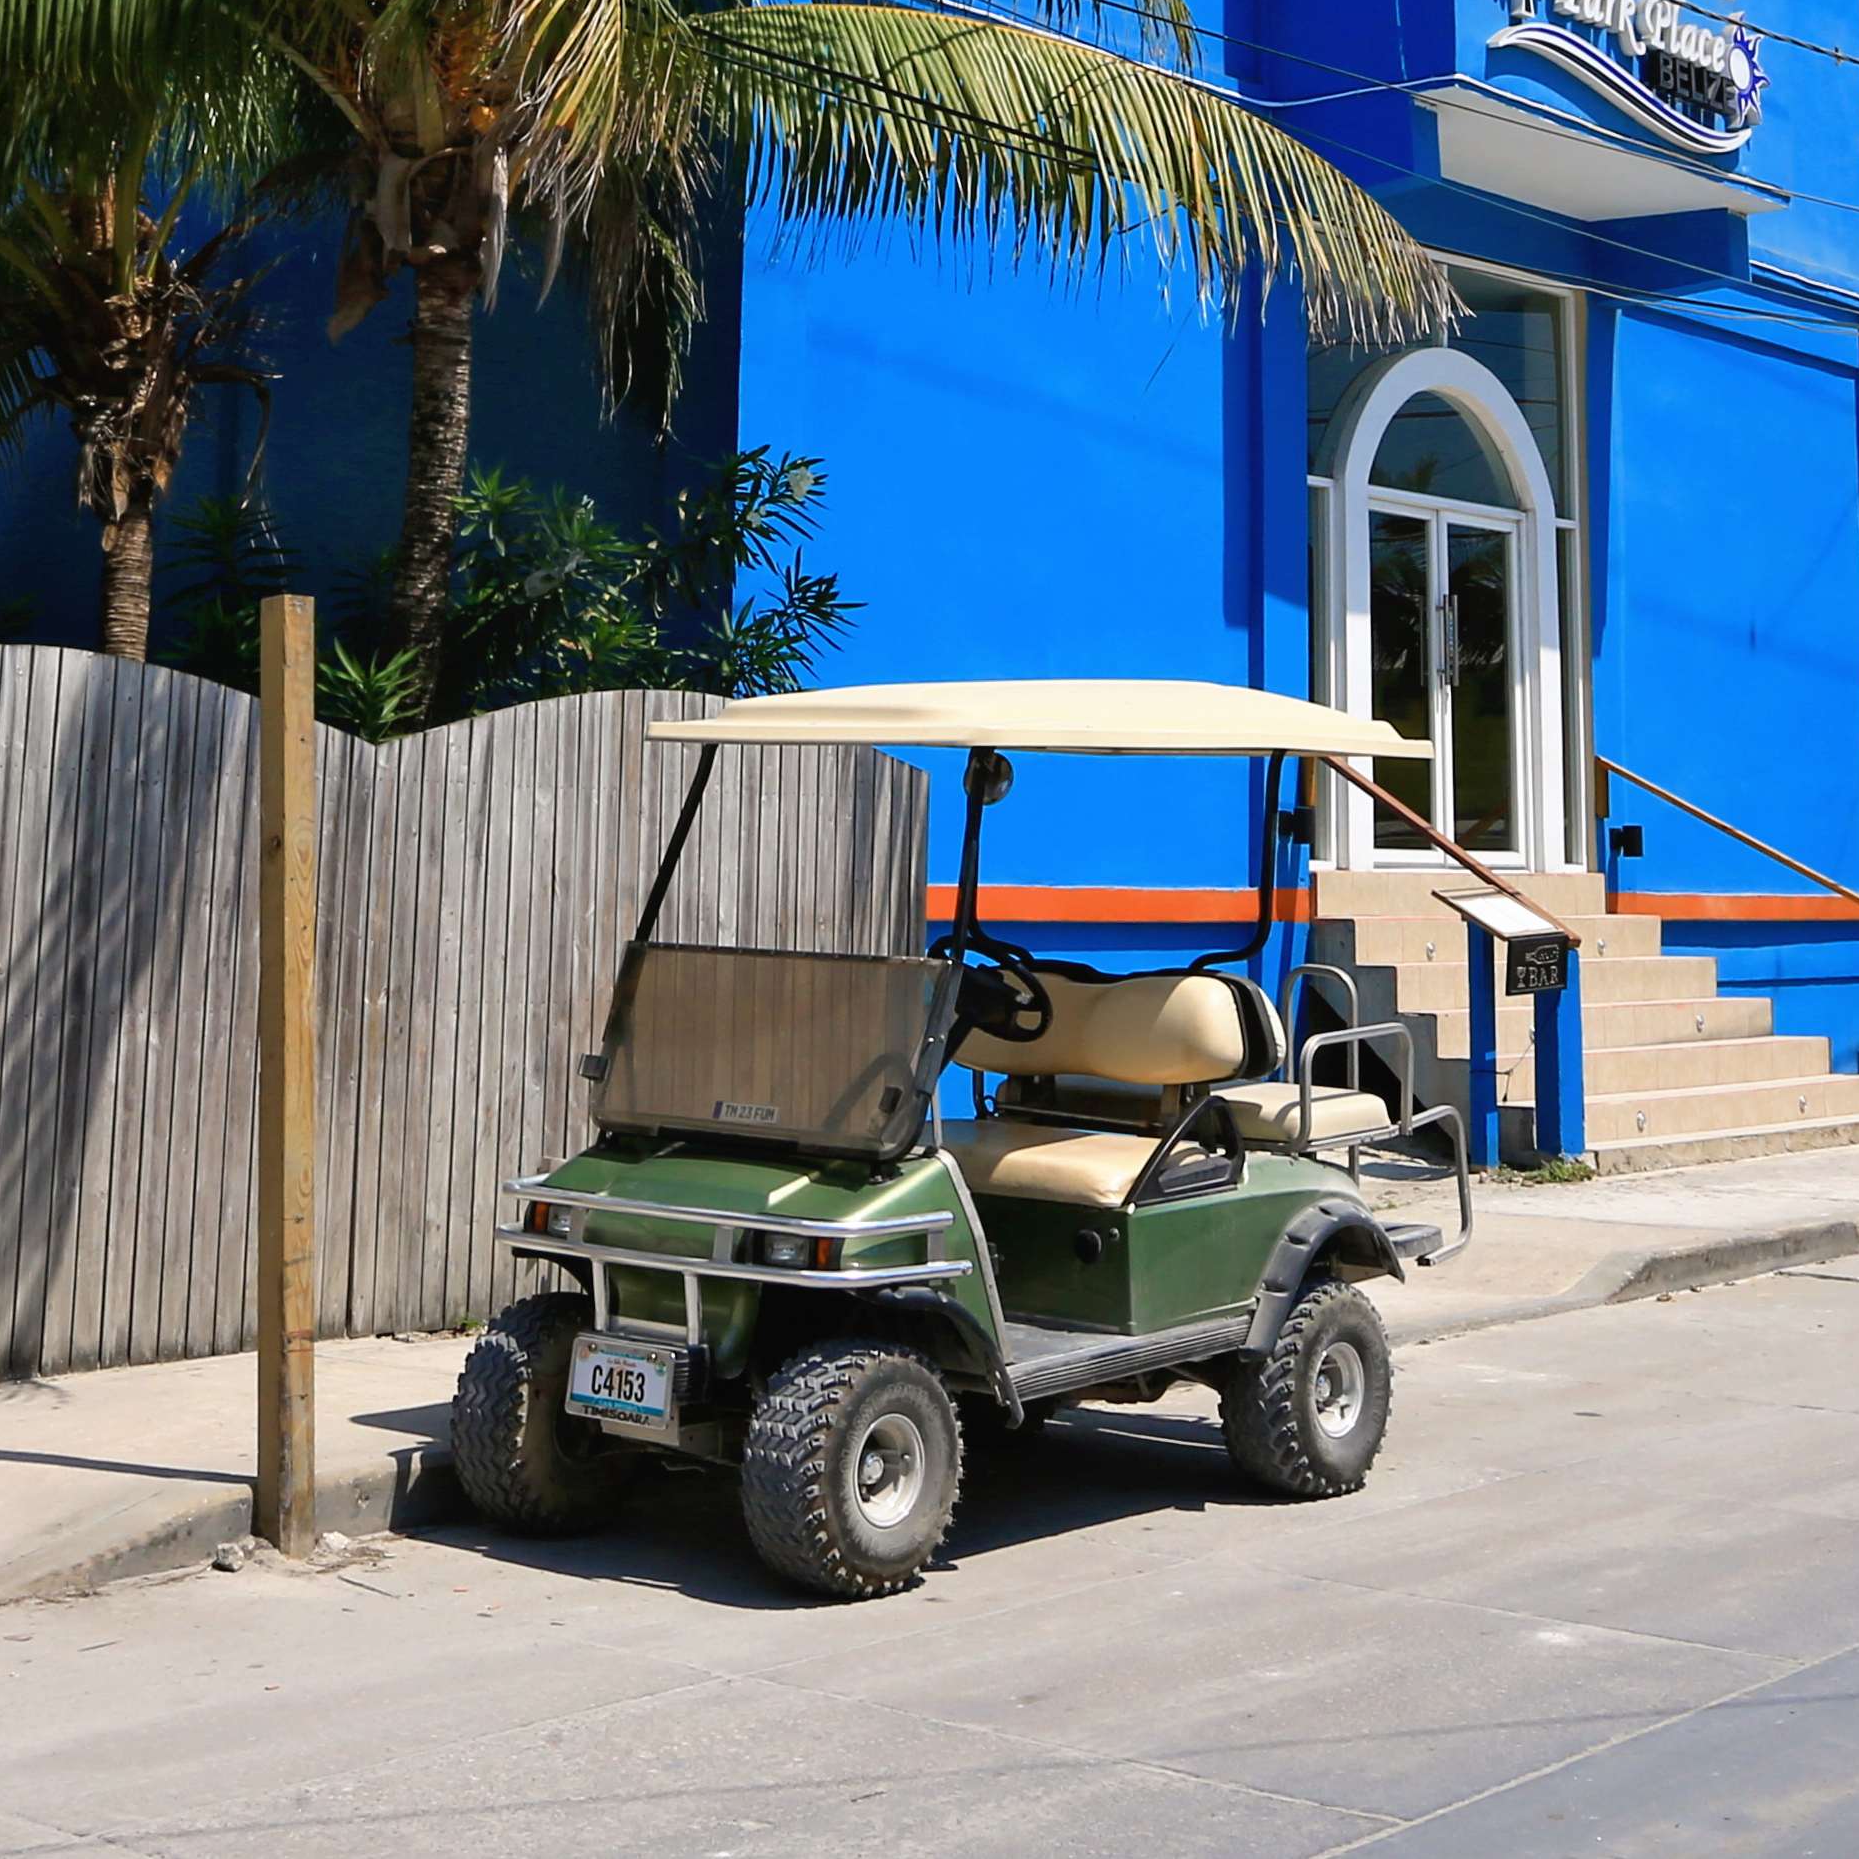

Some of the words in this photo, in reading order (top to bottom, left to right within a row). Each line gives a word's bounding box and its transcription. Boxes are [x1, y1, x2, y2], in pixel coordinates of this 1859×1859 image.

[1656, 50, 1735, 113] BELIZE
[1528, 965, 1559, 988] BAR
[591, 1364, 646, 1403] C4153
